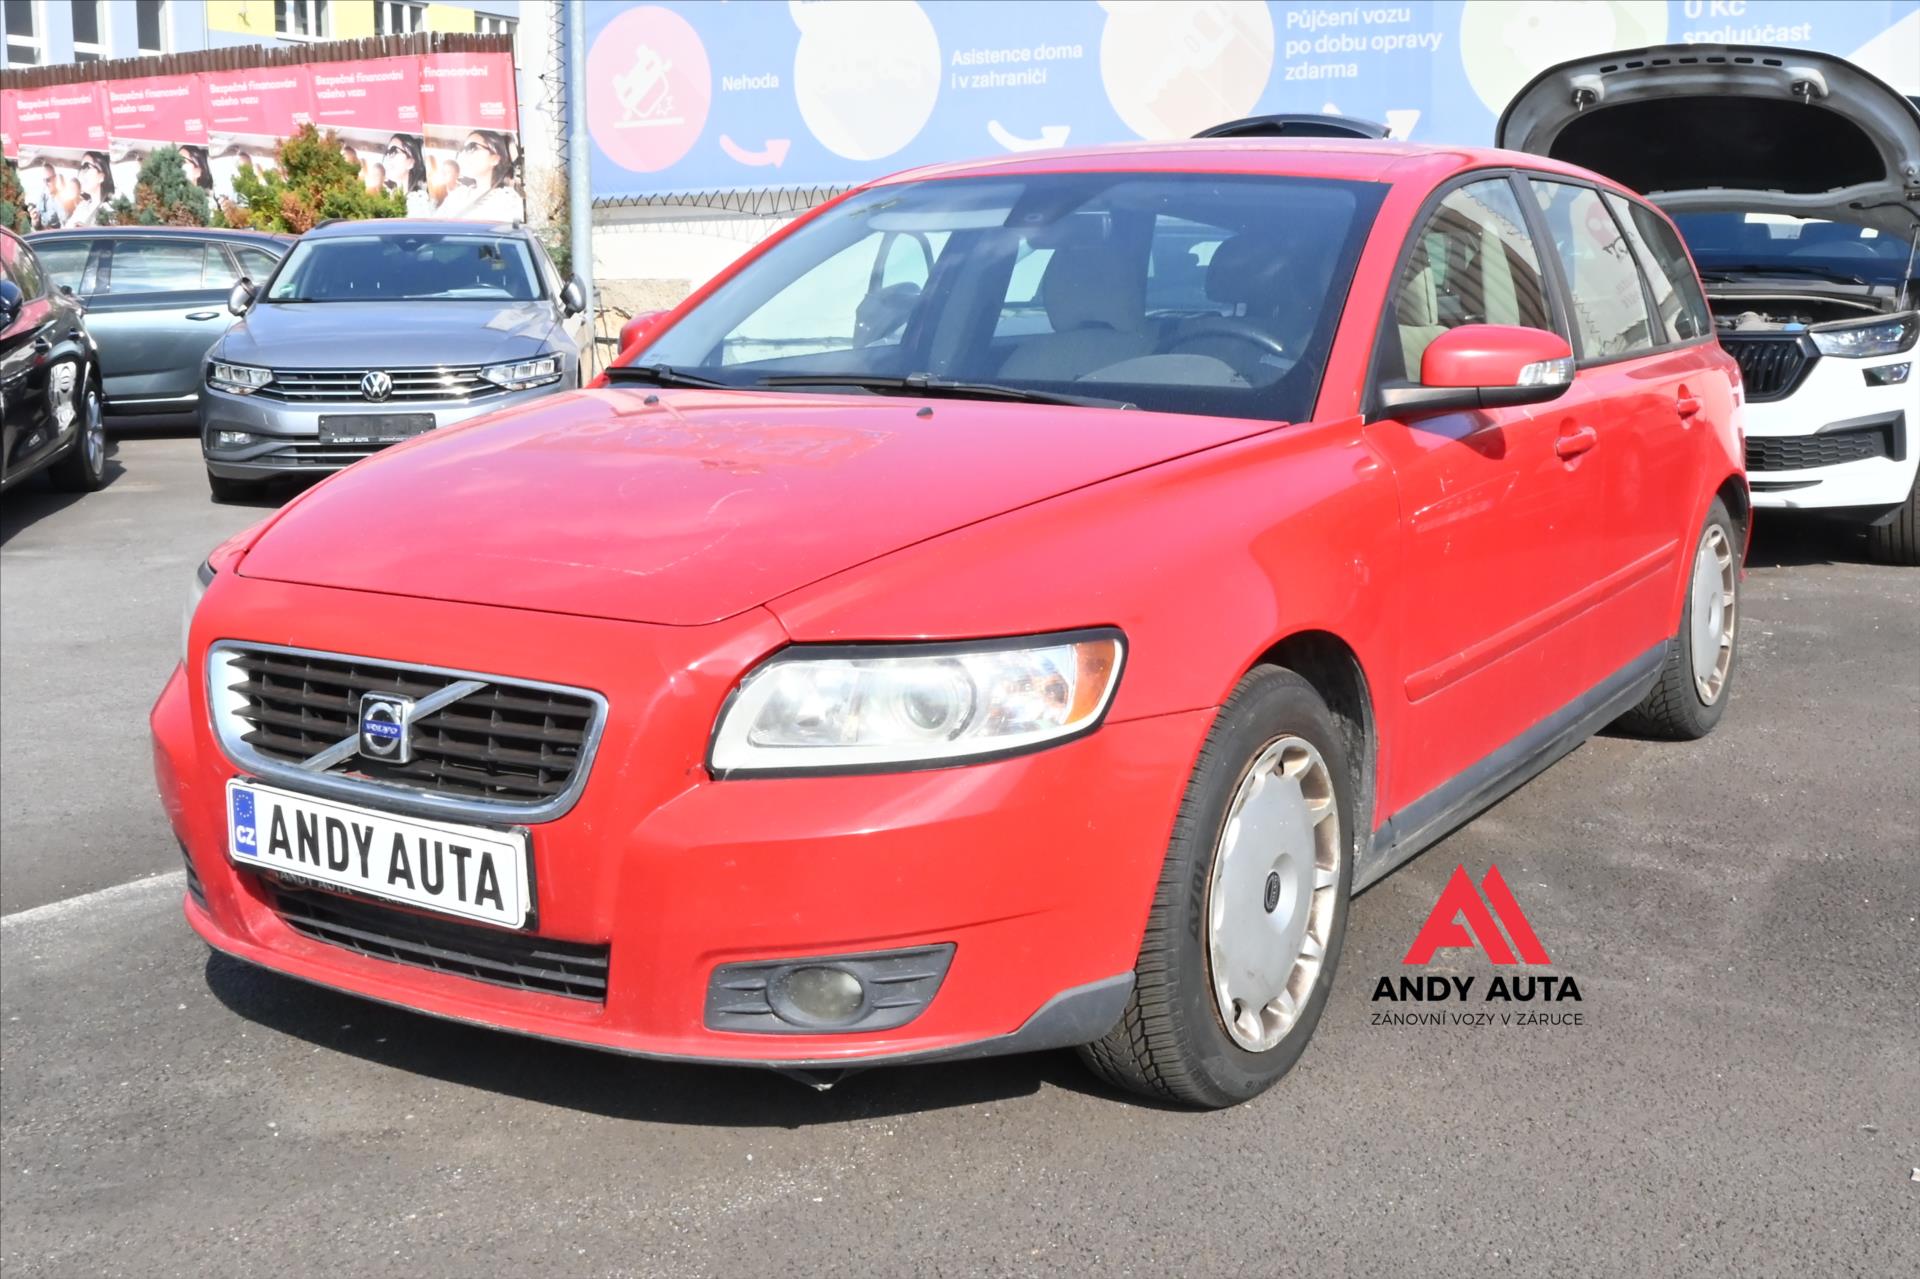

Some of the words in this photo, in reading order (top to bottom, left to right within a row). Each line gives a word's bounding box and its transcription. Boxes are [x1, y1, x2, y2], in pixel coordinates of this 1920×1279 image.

[1286, 8, 1360, 32] Půjčení
[1363, 8, 1411, 25] vozu
[951, 48, 1031, 67] Asistence
[1033, 44, 1083, 61] doma
[1286, 39, 1312, 59] po
[1315, 33, 1367, 54] dobu
[1371, 32, 1443, 54] opravy
[958, 75, 970, 88] v
[972, 68, 1047, 88] zahraničí
[1285, 62, 1358, 81] zdarma
[722, 74, 779, 92] Nehoda
[365, 722, 398, 735] VOLVO
[236, 826, 256, 846] CZ
[268, 804, 374, 878] ANDY
[387, 832, 504, 911] AUTA
